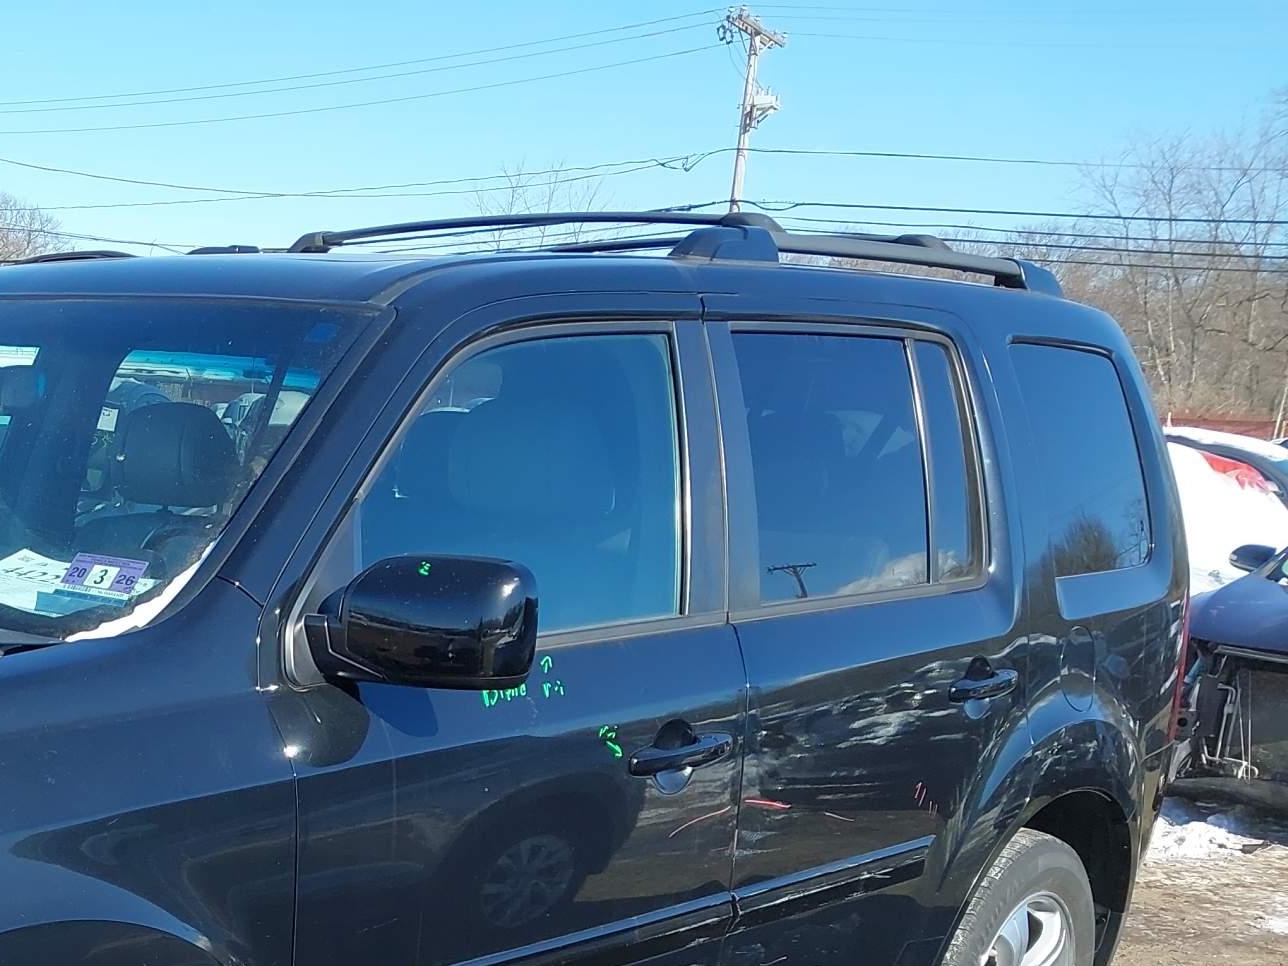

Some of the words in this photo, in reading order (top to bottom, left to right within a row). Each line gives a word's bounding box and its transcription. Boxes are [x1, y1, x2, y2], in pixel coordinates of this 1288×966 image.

[2, 566, 62, 585] 4422
[68, 566, 88, 578] 20
[93, 568, 109, 585] 3
[115, 574, 136, 586] 26
